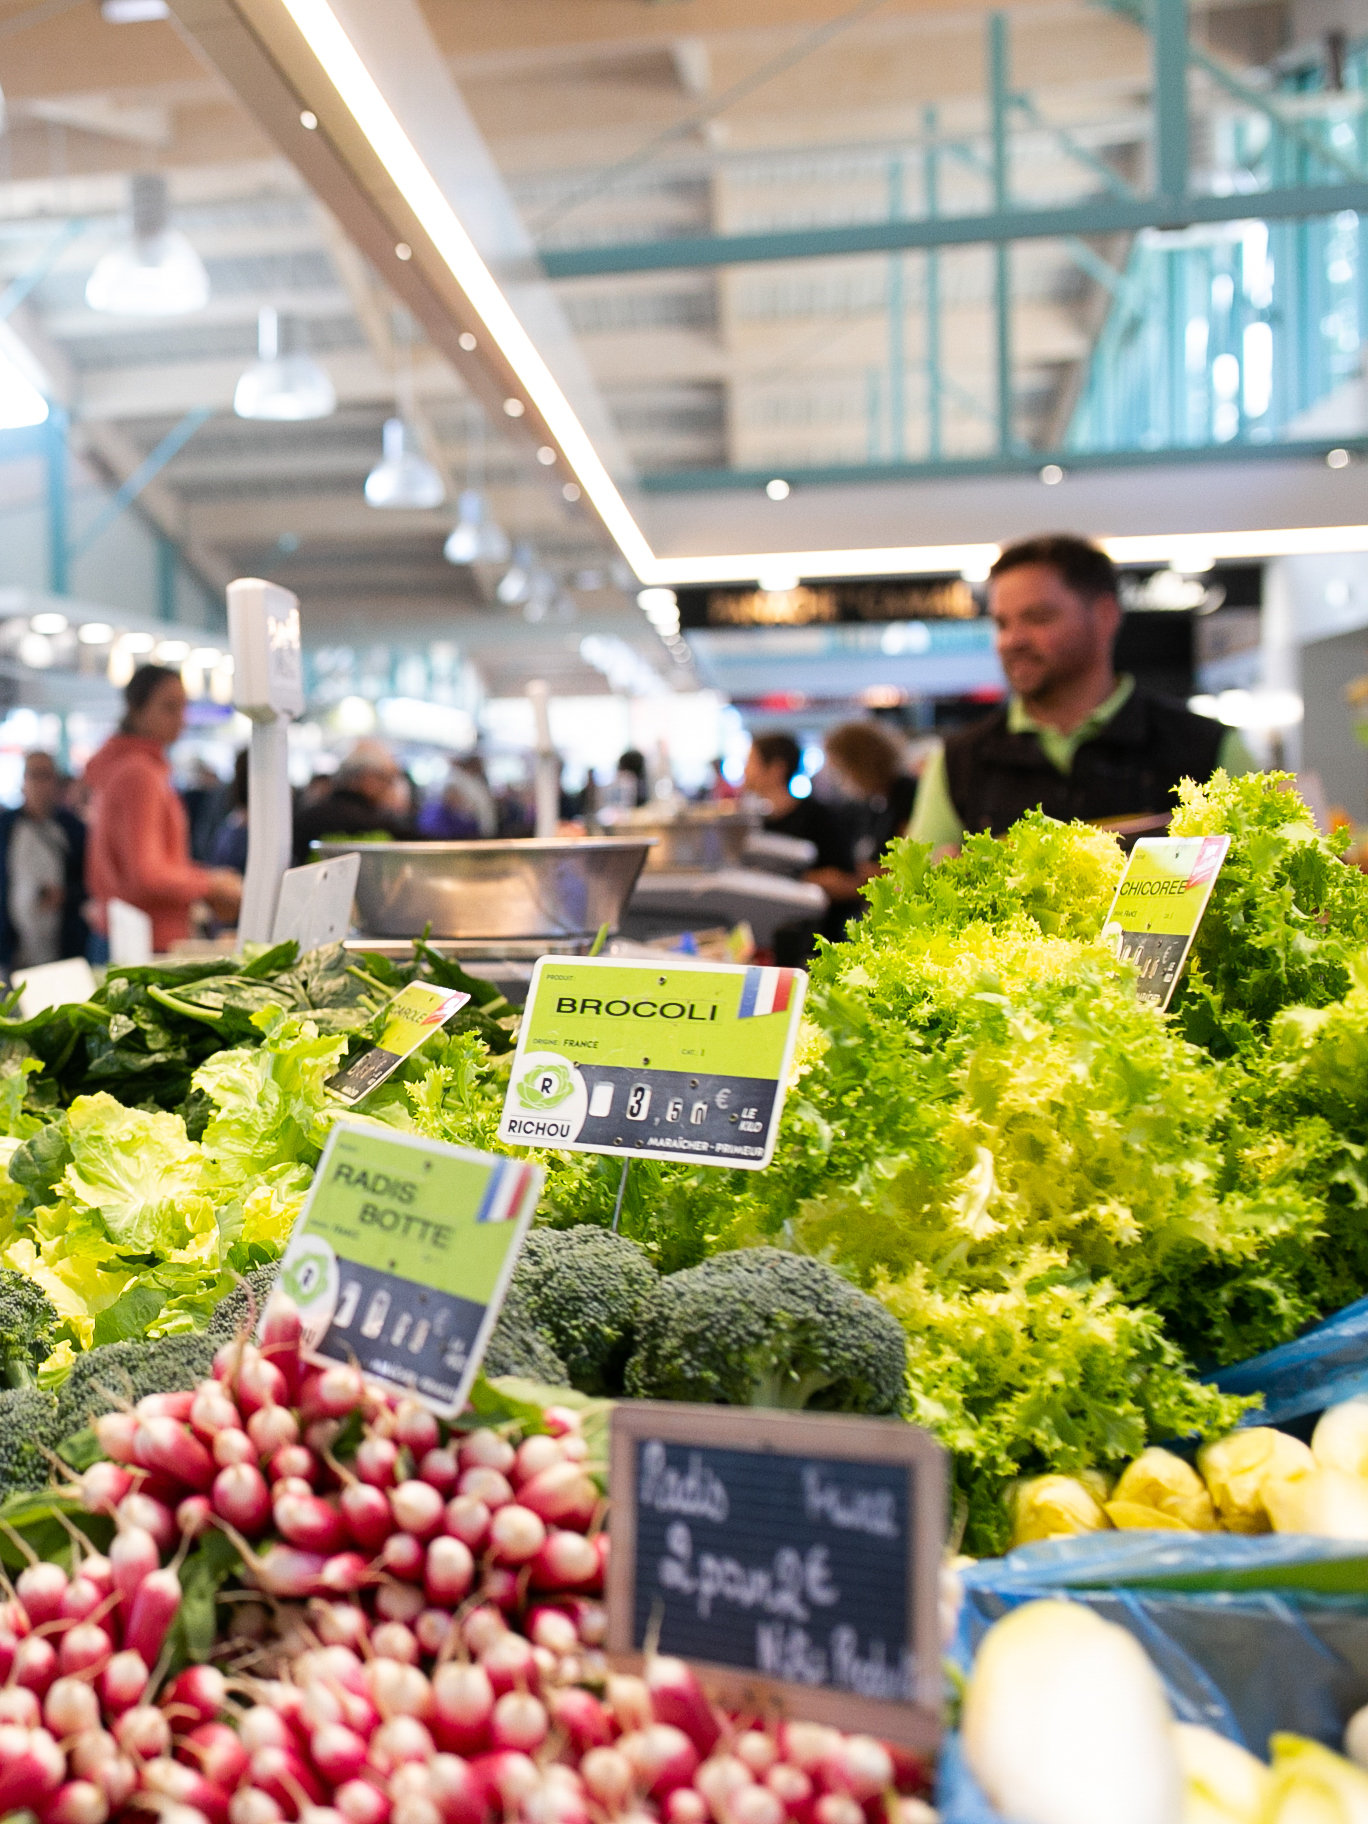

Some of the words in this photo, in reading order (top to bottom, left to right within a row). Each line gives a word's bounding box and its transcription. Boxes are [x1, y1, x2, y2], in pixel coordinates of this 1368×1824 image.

[1119, 879, 1190, 896] CHICOREE
[556, 997, 717, 1021] BROCOLI
[563, 1038, 599, 1049] FRANCE
[541, 1077, 553, 1095] R
[741, 1107, 758, 1119] LE
[507, 1119, 570, 1138] RICHOU
[332, 1163, 419, 1205] RADIS
[359, 1202, 456, 1250] BOTTE
